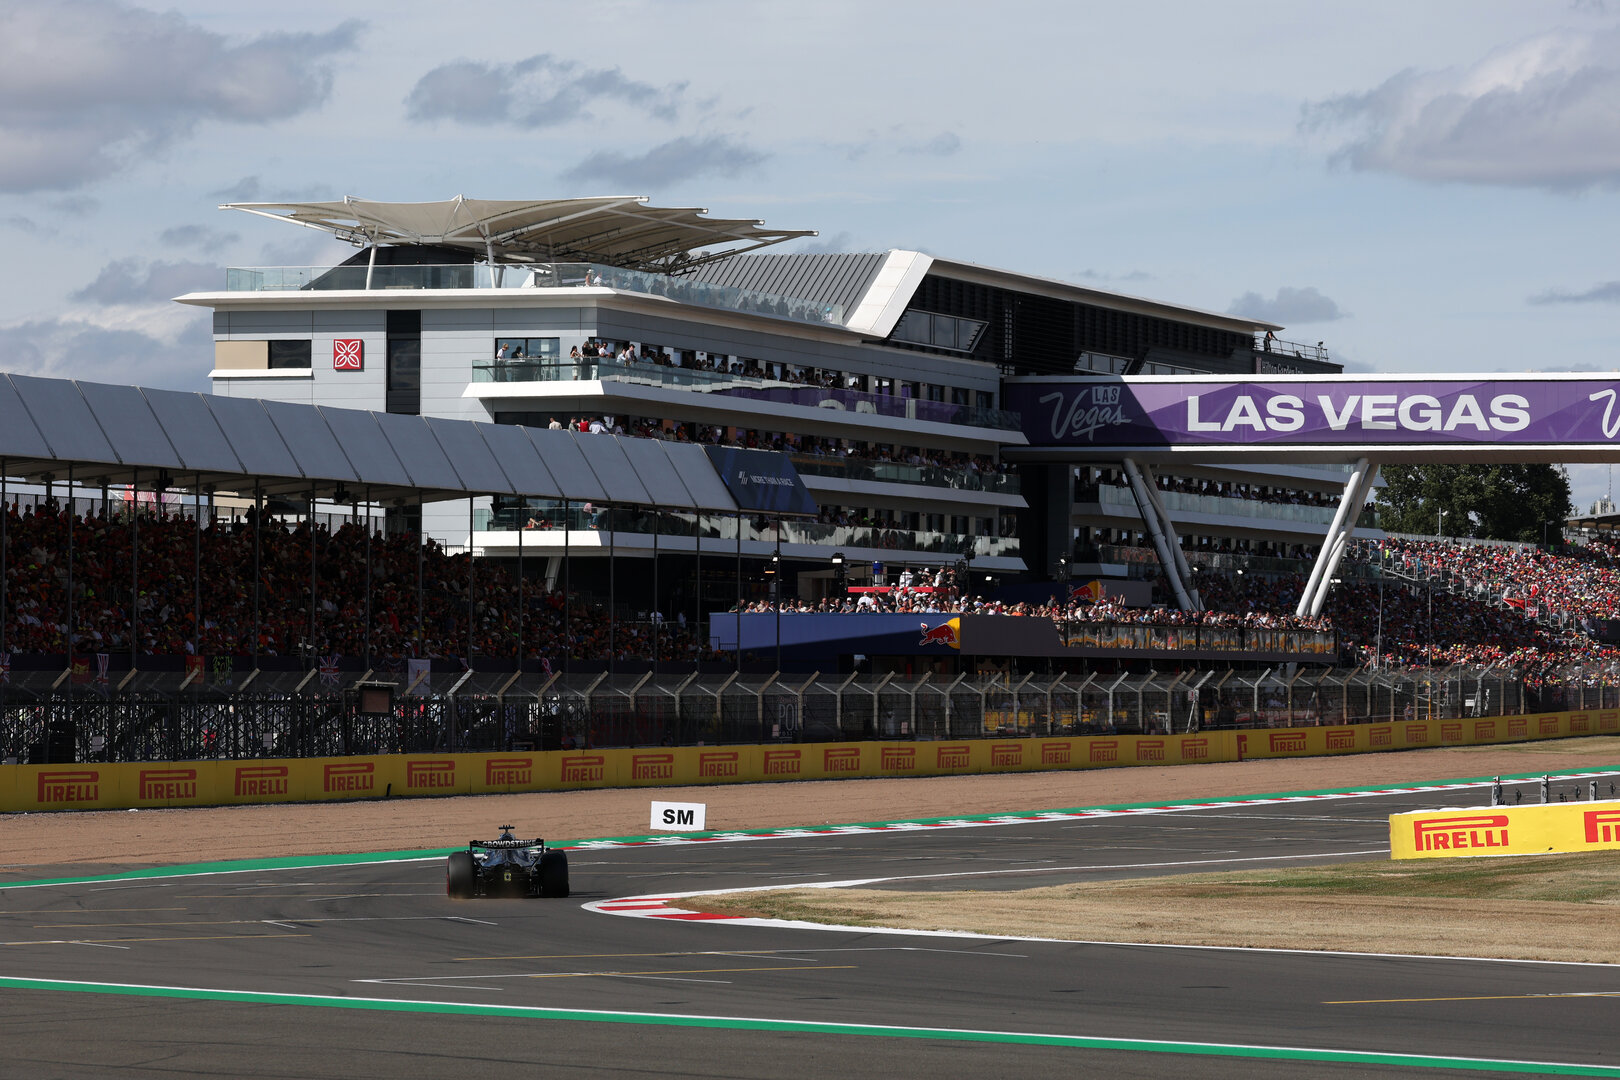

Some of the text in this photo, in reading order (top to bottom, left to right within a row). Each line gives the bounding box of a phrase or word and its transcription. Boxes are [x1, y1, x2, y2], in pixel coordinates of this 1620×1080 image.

[1094, 387, 1118, 403] LAS
[1039, 389, 1132, 442] Vegas
[1187, 394, 1531, 432] LAS VEGAS
[1181, 738, 1208, 759] PIRELLI
[1269, 732, 1306, 752] PIRELLI
[1326, 730, 1355, 750] PIRELLI
[1369, 727, 1392, 746] PIRELLI
[764, 749, 802, 775] PIRELLI
[824, 747, 860, 772] PIRELLI
[881, 747, 916, 770] PIRELLI
[937, 746, 971, 769] PIRELLI
[991, 743, 1023, 766] PIRELLI
[1042, 742, 1072, 764] PIRELLI
[1089, 741, 1118, 762] PIRELLI
[1136, 740, 1165, 761] PIRELLI
[408, 761, 456, 787] PIRELLI
[486, 758, 533, 785] PIRELLI
[562, 755, 604, 781] PIRELLI
[632, 753, 674, 780] PIRELLI
[700, 751, 739, 777] PIRELLI
[38, 771, 98, 801] PIRELLI
[140, 769, 197, 798] PIRELLI
[236, 766, 289, 794] PIRELLI
[324, 762, 375, 792] PIRELLI
[662, 809, 694, 825] SM
[483, 840, 536, 848] CROWDSTRIKE
[1414, 815, 1509, 851] PIRELLI
